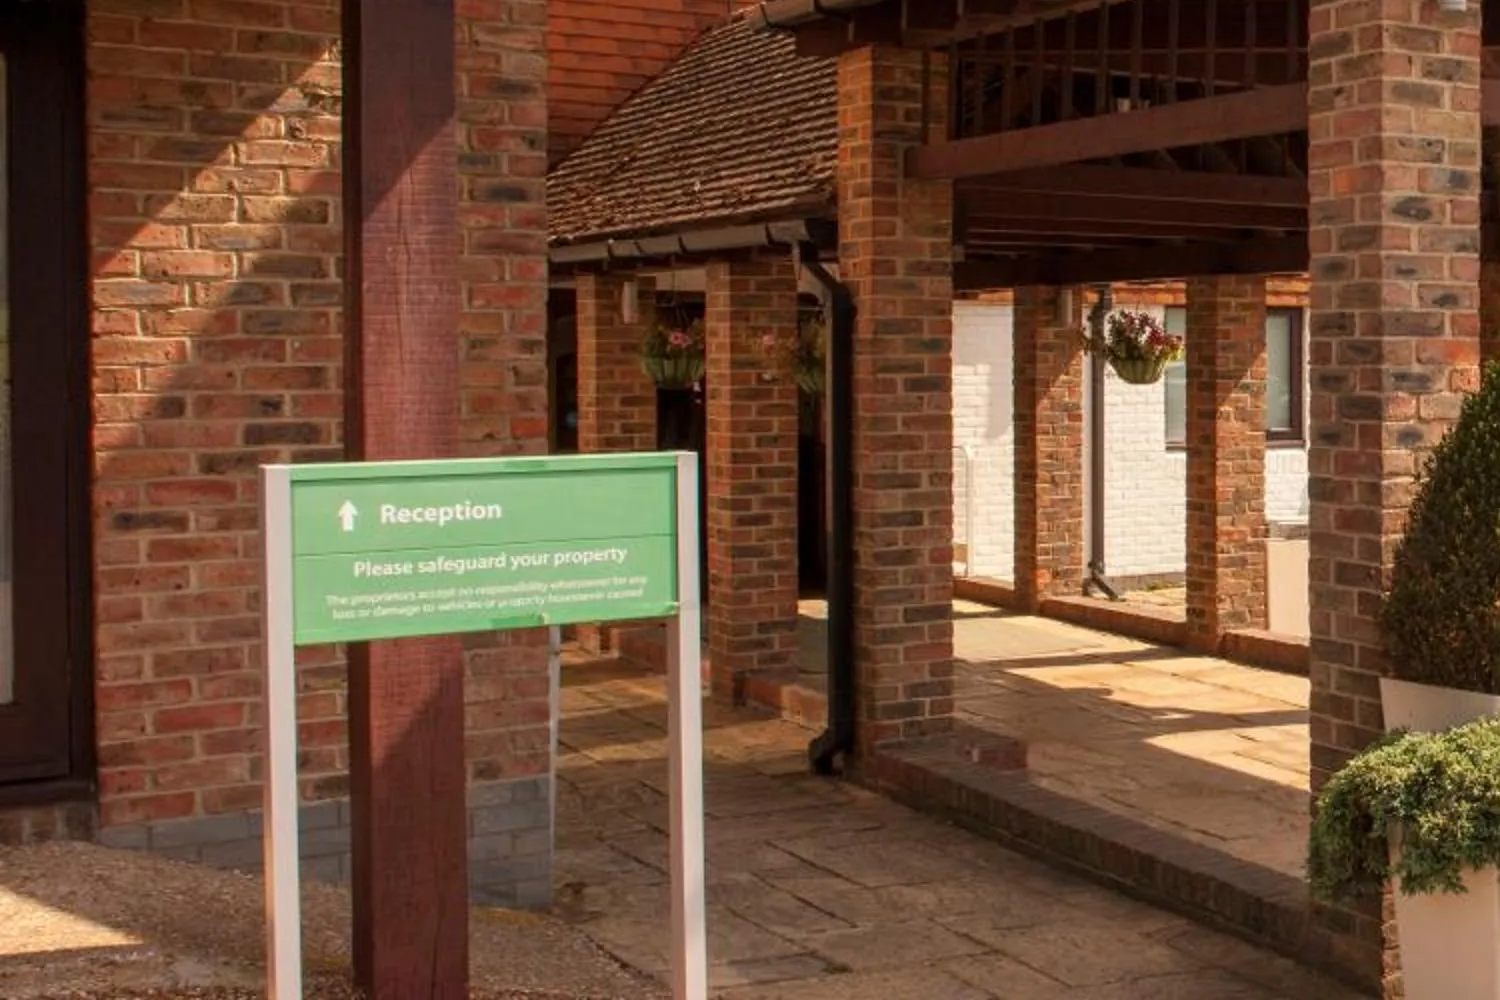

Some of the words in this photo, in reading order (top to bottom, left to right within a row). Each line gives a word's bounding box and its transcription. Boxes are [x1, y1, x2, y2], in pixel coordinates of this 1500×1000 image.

[380, 501, 503, 526] Reception
[353, 558, 413, 577] Please
[417, 551, 507, 575] safeguard
[509, 551, 550, 570] your
[553, 545, 628, 566] property
